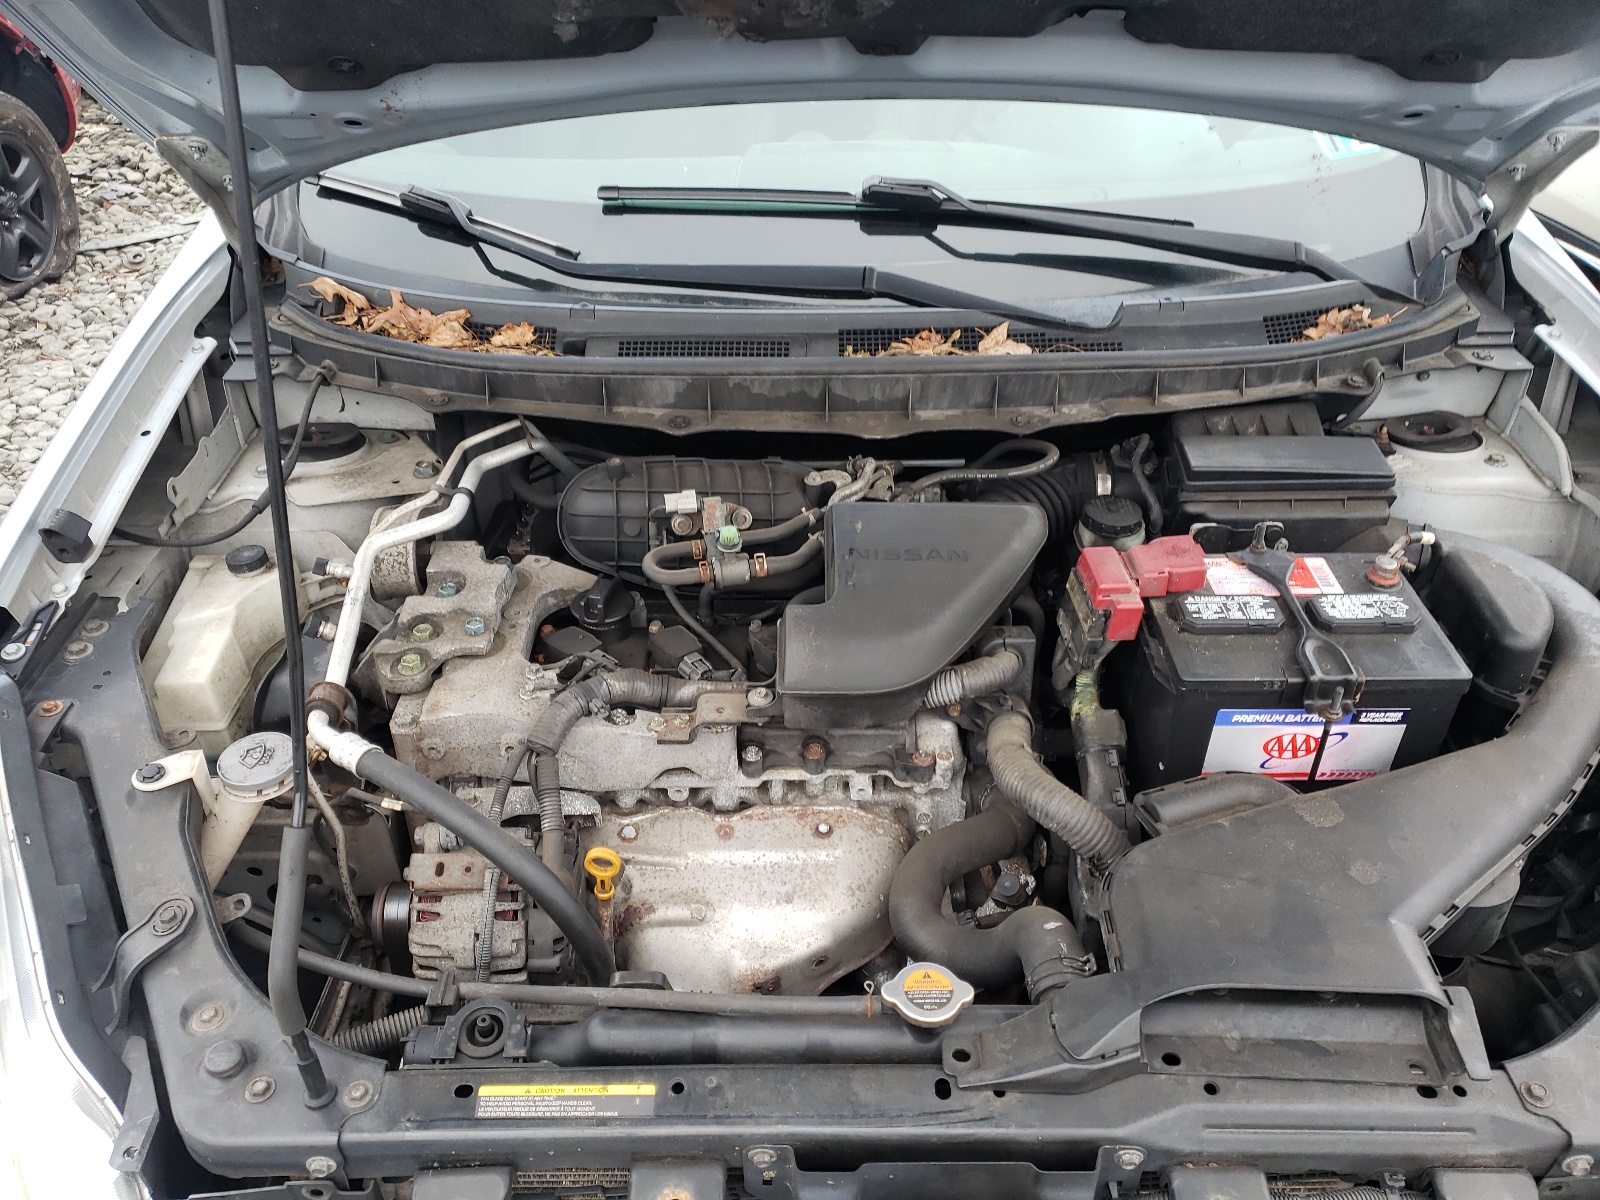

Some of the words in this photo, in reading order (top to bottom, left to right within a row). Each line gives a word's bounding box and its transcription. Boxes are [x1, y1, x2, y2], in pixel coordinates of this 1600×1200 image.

[848, 548, 969, 561] NISSAN
[1231, 714, 1284, 723] PREMIUM
[1284, 714, 1326, 723] BATTER
[1266, 734, 1316, 758] AAA
